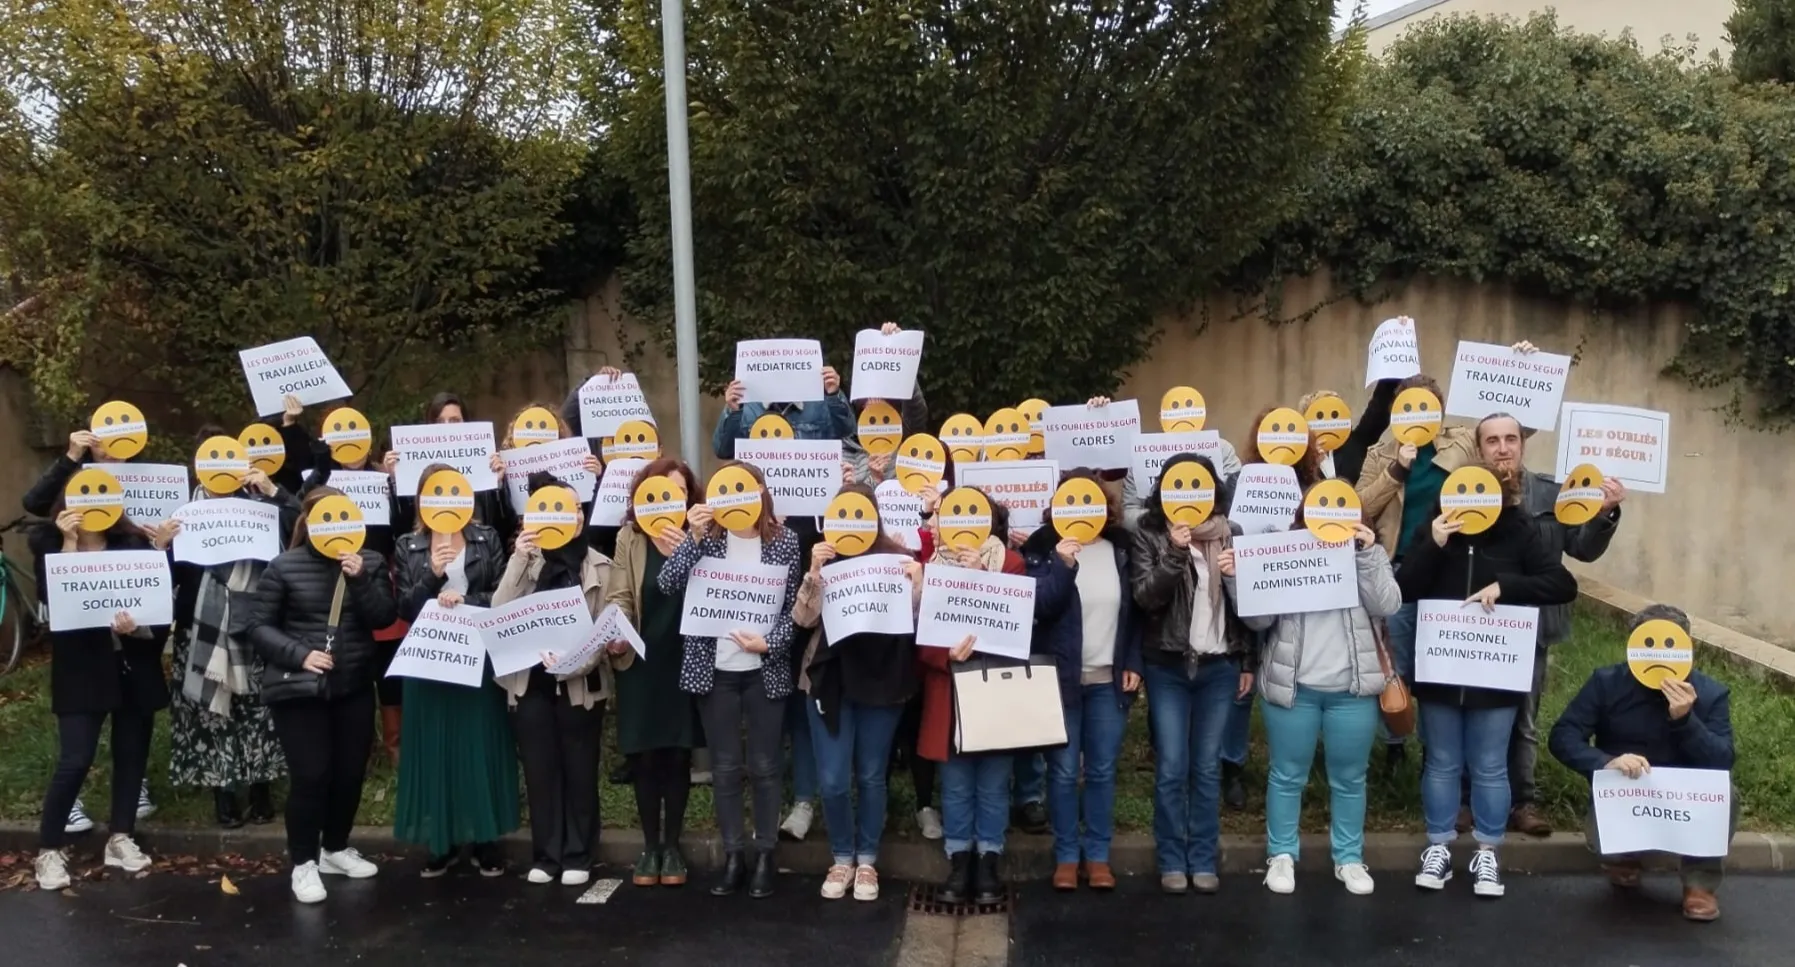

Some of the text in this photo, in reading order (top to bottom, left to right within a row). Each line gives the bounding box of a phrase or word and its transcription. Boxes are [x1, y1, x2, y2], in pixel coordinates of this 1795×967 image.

[247, 360, 260, 369] LES
[262, 352, 296, 364] OUBLIES
[297, 348, 310, 357] DU
[738, 349, 819, 359] LES OUBLIES DU SEGUR
[885, 347, 897, 355] DU
[898, 348, 920, 356] SEGUR
[746, 361, 812, 373] MEDIATRICES
[860, 361, 901, 372] CADRES
[1460, 353, 1564, 376] LES OUBLIES DU SEGUR
[279, 376, 327, 394] SOCIAUX
[1465, 370, 1553, 392] TRAVAILLEURS
[583, 395, 623, 405] CHARGEE
[1478, 390, 1532, 408] SOCIAUX
[1046, 422, 1060, 431] LES
[1061, 420, 1094, 431] OUBLIES
[1096, 419, 1109, 429] DU
[1110, 418, 1138, 428] SEGUR
[396, 436, 410, 445] LES
[412, 434, 447, 444] OUBLIES
[464, 432, 492, 441] SEGUR
[1072, 434, 1116, 447] CADRES
[1577, 428, 1658, 445] LES OUBLIÉS
[405, 447, 487, 461] TRAVAILLEURS
[1134, 445, 1147, 453] LES
[1149, 444, 1184, 452] OUBLIES
[1197, 441, 1219, 450] SEGUR
[1580, 446, 1602, 456] DU
[1605, 446, 1646, 462] SÉGUR
[519, 454, 549, 466] OUBLIES
[550, 451, 562, 460] DU
[755, 452, 792, 460] OUBLIES
[794, 452, 808, 460] DU
[810, 452, 839, 460] SEGUR
[141, 475, 154, 483] DU
[156, 476, 185, 484] SEGUR
[570, 472, 585, 482] 115
[1246, 475, 1292, 485] OUBLIES DU
[123, 489, 179, 500] AILLEURS
[994, 481, 1049, 494] OUBLIÉS
[192, 507, 229, 517] OUBLIES
[232, 507, 246, 515] DU
[248, 509, 276, 520] SEGUR
[184, 519, 270, 532] TRAVAILLEURS
[201, 534, 254, 548] SOCIAUX
[1239, 549, 1255, 558] LES
[1257, 544, 1297, 556] OUBLIES
[1300, 542, 1315, 551] DU
[51, 561, 165, 575] LES OUBLIES DU SEGUR
[1263, 557, 1330, 572] PERSONNEL
[693, 567, 708, 578] LES
[710, 571, 749, 583] OUBLIES
[751, 576, 765, 585] DU
[830, 568, 866, 584] OUBLIES
[868, 566, 882, 575] DU
[1253, 573, 1342, 591] ADMINISTRATIF
[61, 577, 160, 592] TRAVAILLEURS
[927, 577, 1033, 599] LES OUBLIES DU SEGUR
[706, 587, 777, 605] PERSONNEL
[825, 582, 903, 604] TRAVAILLEURS
[82, 597, 142, 610] SOCIAUX
[842, 602, 889, 617] SOCIAUX
[947, 596, 1012, 614] PERSONNEL
[442, 613, 457, 623] DU
[479, 598, 582, 630] LES OUBLIES DU SEGUR
[934, 611, 1020, 632] ADMINISTRATIF
[1420, 612, 1533, 630] LES OUBLIES DU SEGUR
[497, 613, 578, 640] MEDIATRICES
[1438, 629, 1507, 646] PERSONNEL
[1426, 646, 1519, 664] ADMINISTRATIF
[1598, 788, 1725, 803] LES OUBLIES DU SEGUR
[1632, 804, 1691, 822] CADRES
